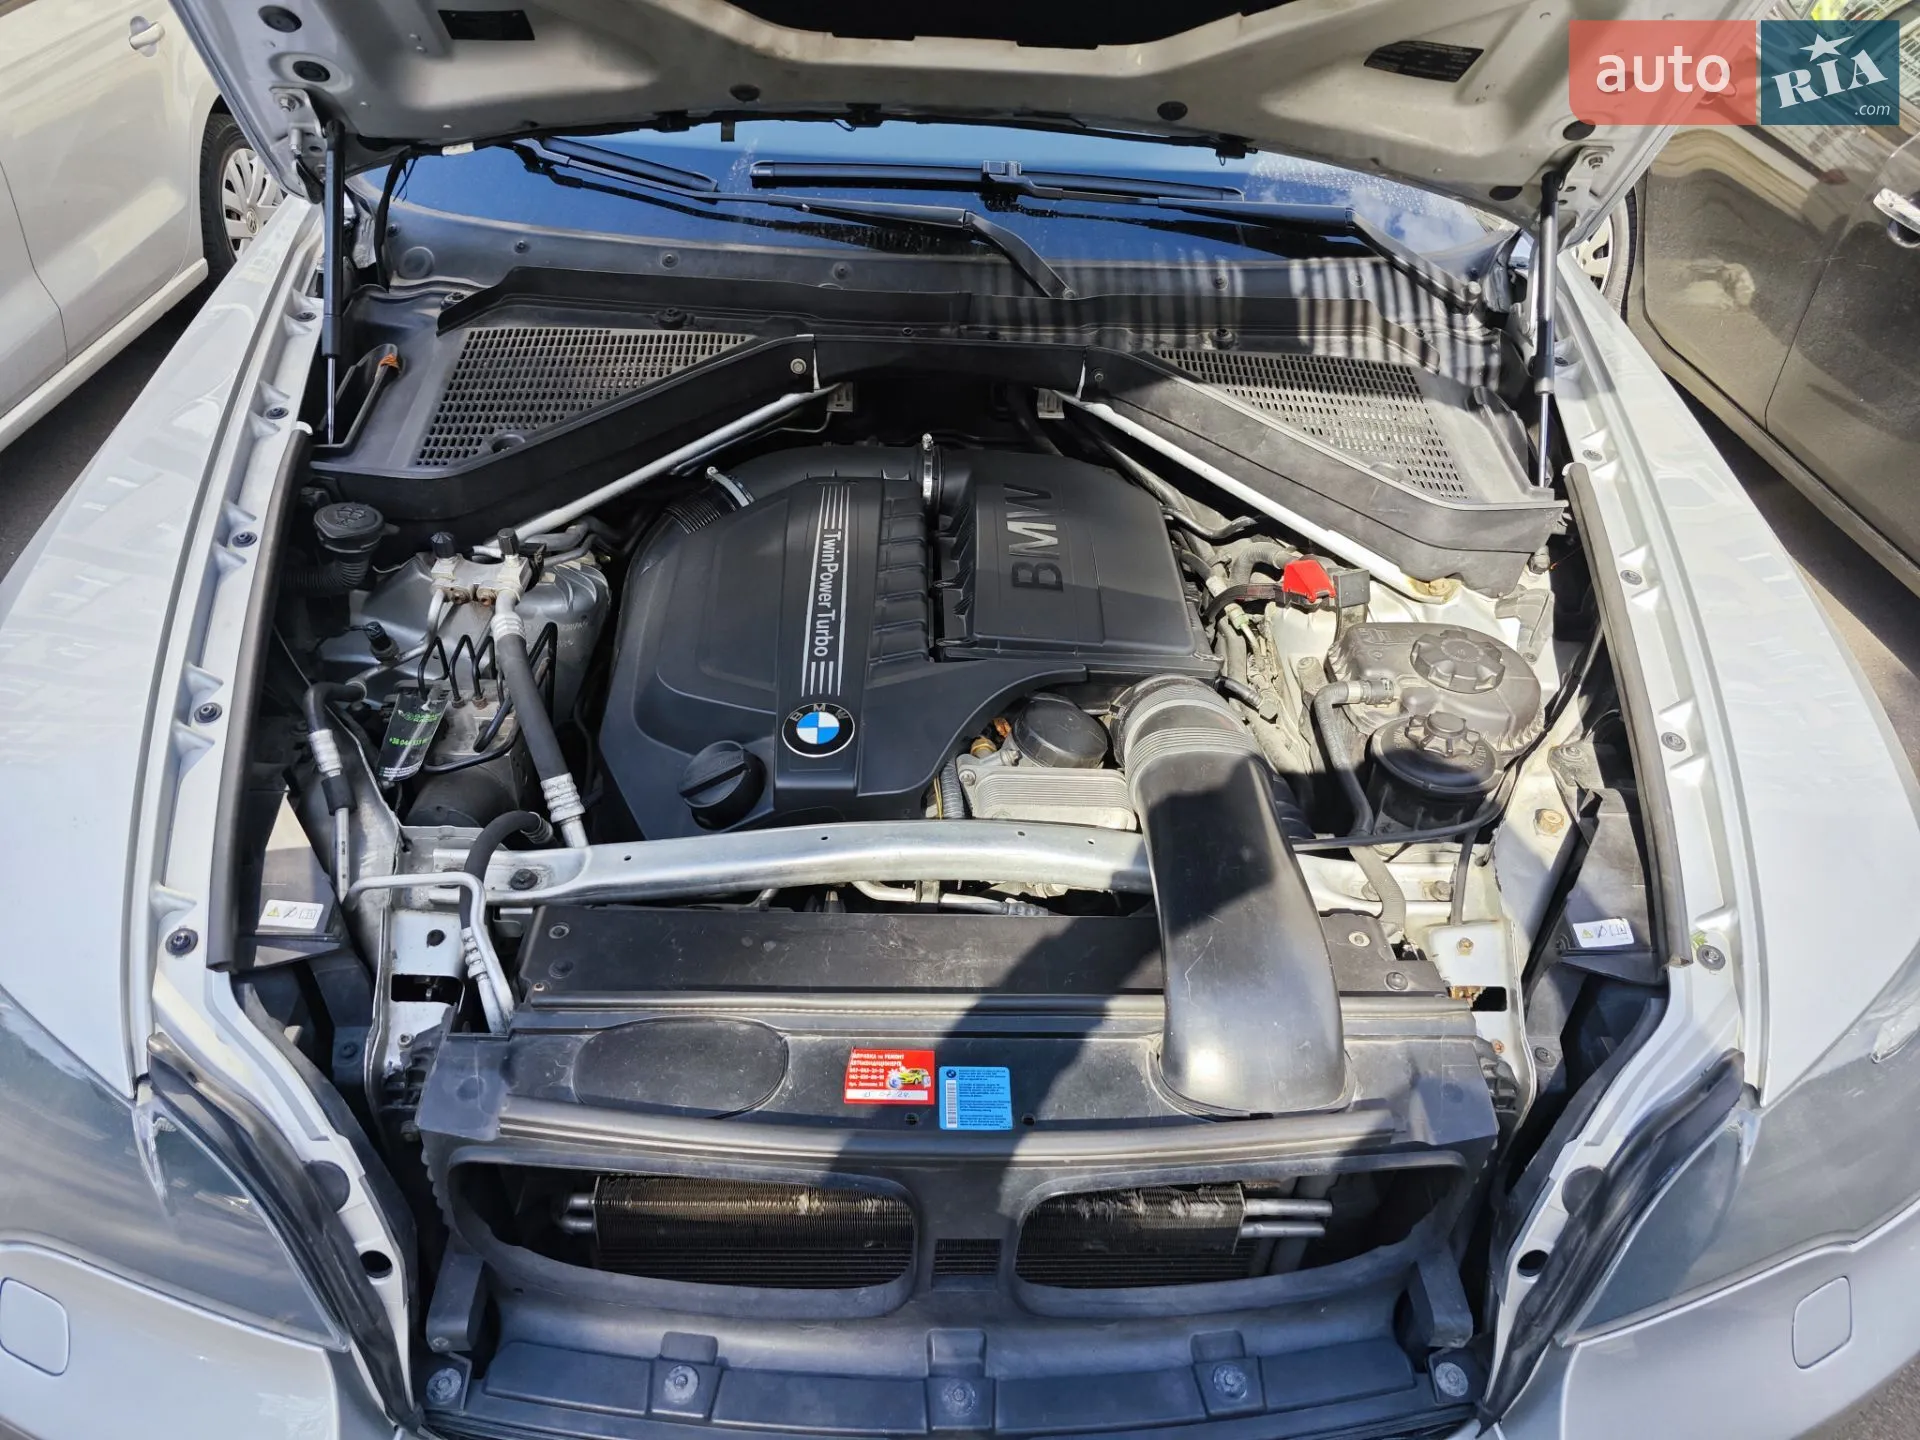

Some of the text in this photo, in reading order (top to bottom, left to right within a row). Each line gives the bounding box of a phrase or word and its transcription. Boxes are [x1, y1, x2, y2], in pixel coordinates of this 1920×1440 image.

[1003, 483, 1064, 592] BMW
[813, 530, 841, 657] TwinPower Turbo
[790, 703, 848, 721] BMW
